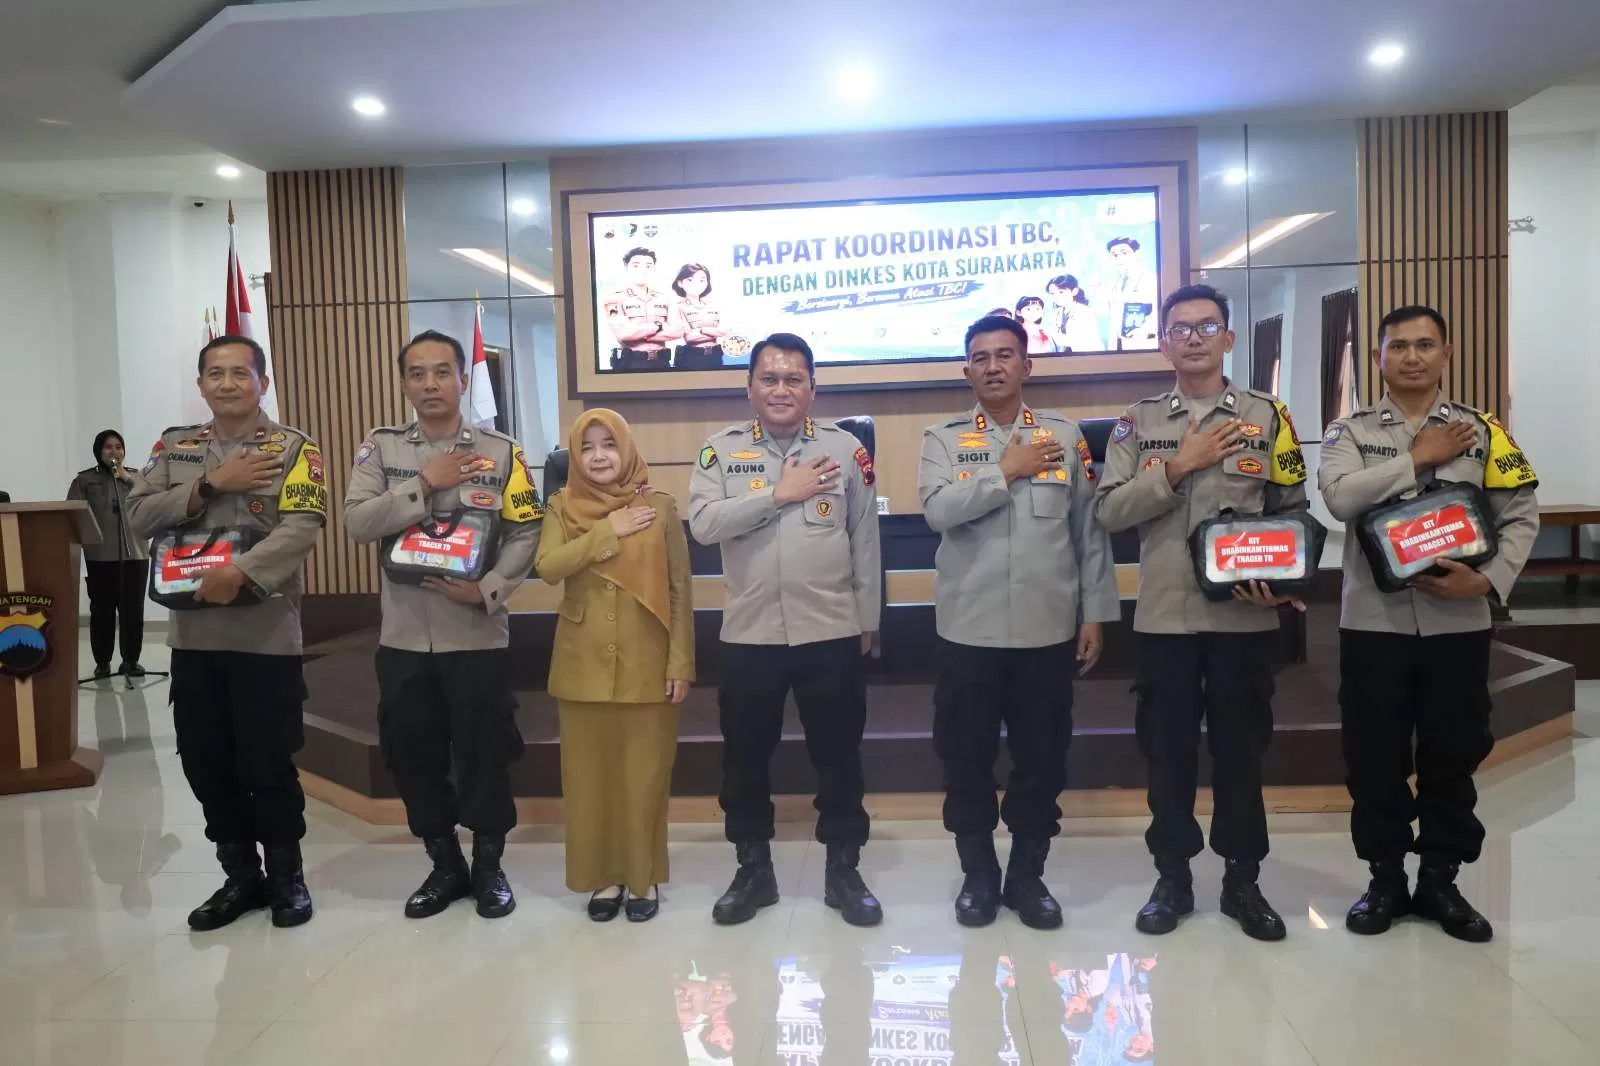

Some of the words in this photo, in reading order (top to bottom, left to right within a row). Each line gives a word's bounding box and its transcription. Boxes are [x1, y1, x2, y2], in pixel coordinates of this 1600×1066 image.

[733, 238, 826, 267] RAPAT
[835, 224, 997, 259] KOORDINASI
[1006, 221, 1059, 245] TBC,
[743, 272, 817, 296] DENGAN
[825, 265, 895, 289] DINKES
[903, 260, 949, 281] KOTA
[956, 250, 1066, 276] SURAKARTA
[938, 282, 968, 296] TBC!
[1239, 439, 1270, 452] OLRI
[958, 453, 990, 462] SIGIT
[727, 464, 765, 473] AGUNG
[471, 475, 502, 487] OLRI
[1422, 520, 1435, 530] KIT
[1445, 535, 1456, 544] TB
[1264, 554, 1274, 562] TB
[10, 596, 52, 606] TENGAH
